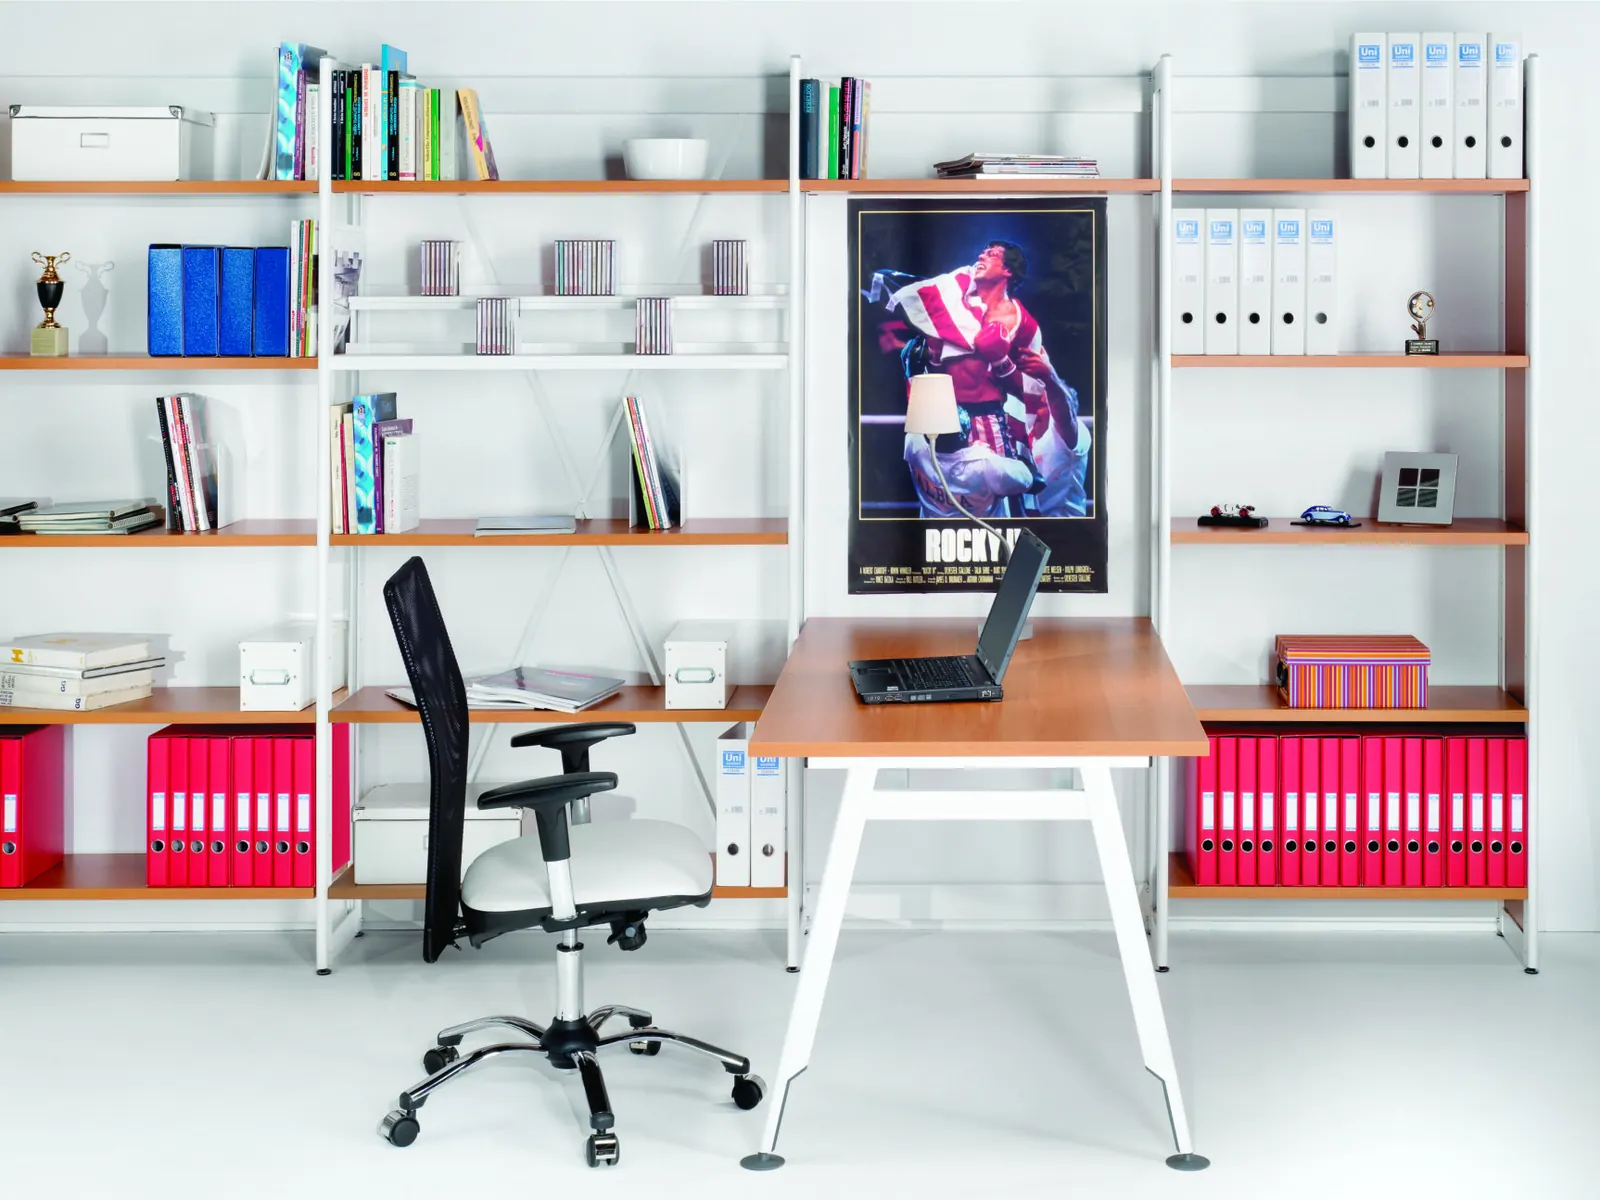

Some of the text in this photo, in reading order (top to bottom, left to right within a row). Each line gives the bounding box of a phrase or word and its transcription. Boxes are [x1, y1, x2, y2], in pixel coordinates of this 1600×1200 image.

[1361, 47, 1377, 56] Uni
[1395, 46, 1410, 55] Uni
[1429, 46, 1445, 55] Uni
[1462, 46, 1478, 55] Uni
[1498, 46, 1514, 55] Uni
[1180, 223, 1195, 232] Uni
[1213, 224, 1229, 232] Uni
[1246, 223, 1262, 232] Uni
[1280, 223, 1296, 232] Uni
[1314, 223, 1330, 232] Uni
[925, 528, 1002, 563] ROCKY
[74, 698, 81, 709] GG
[725, 753, 742, 761] Uni
